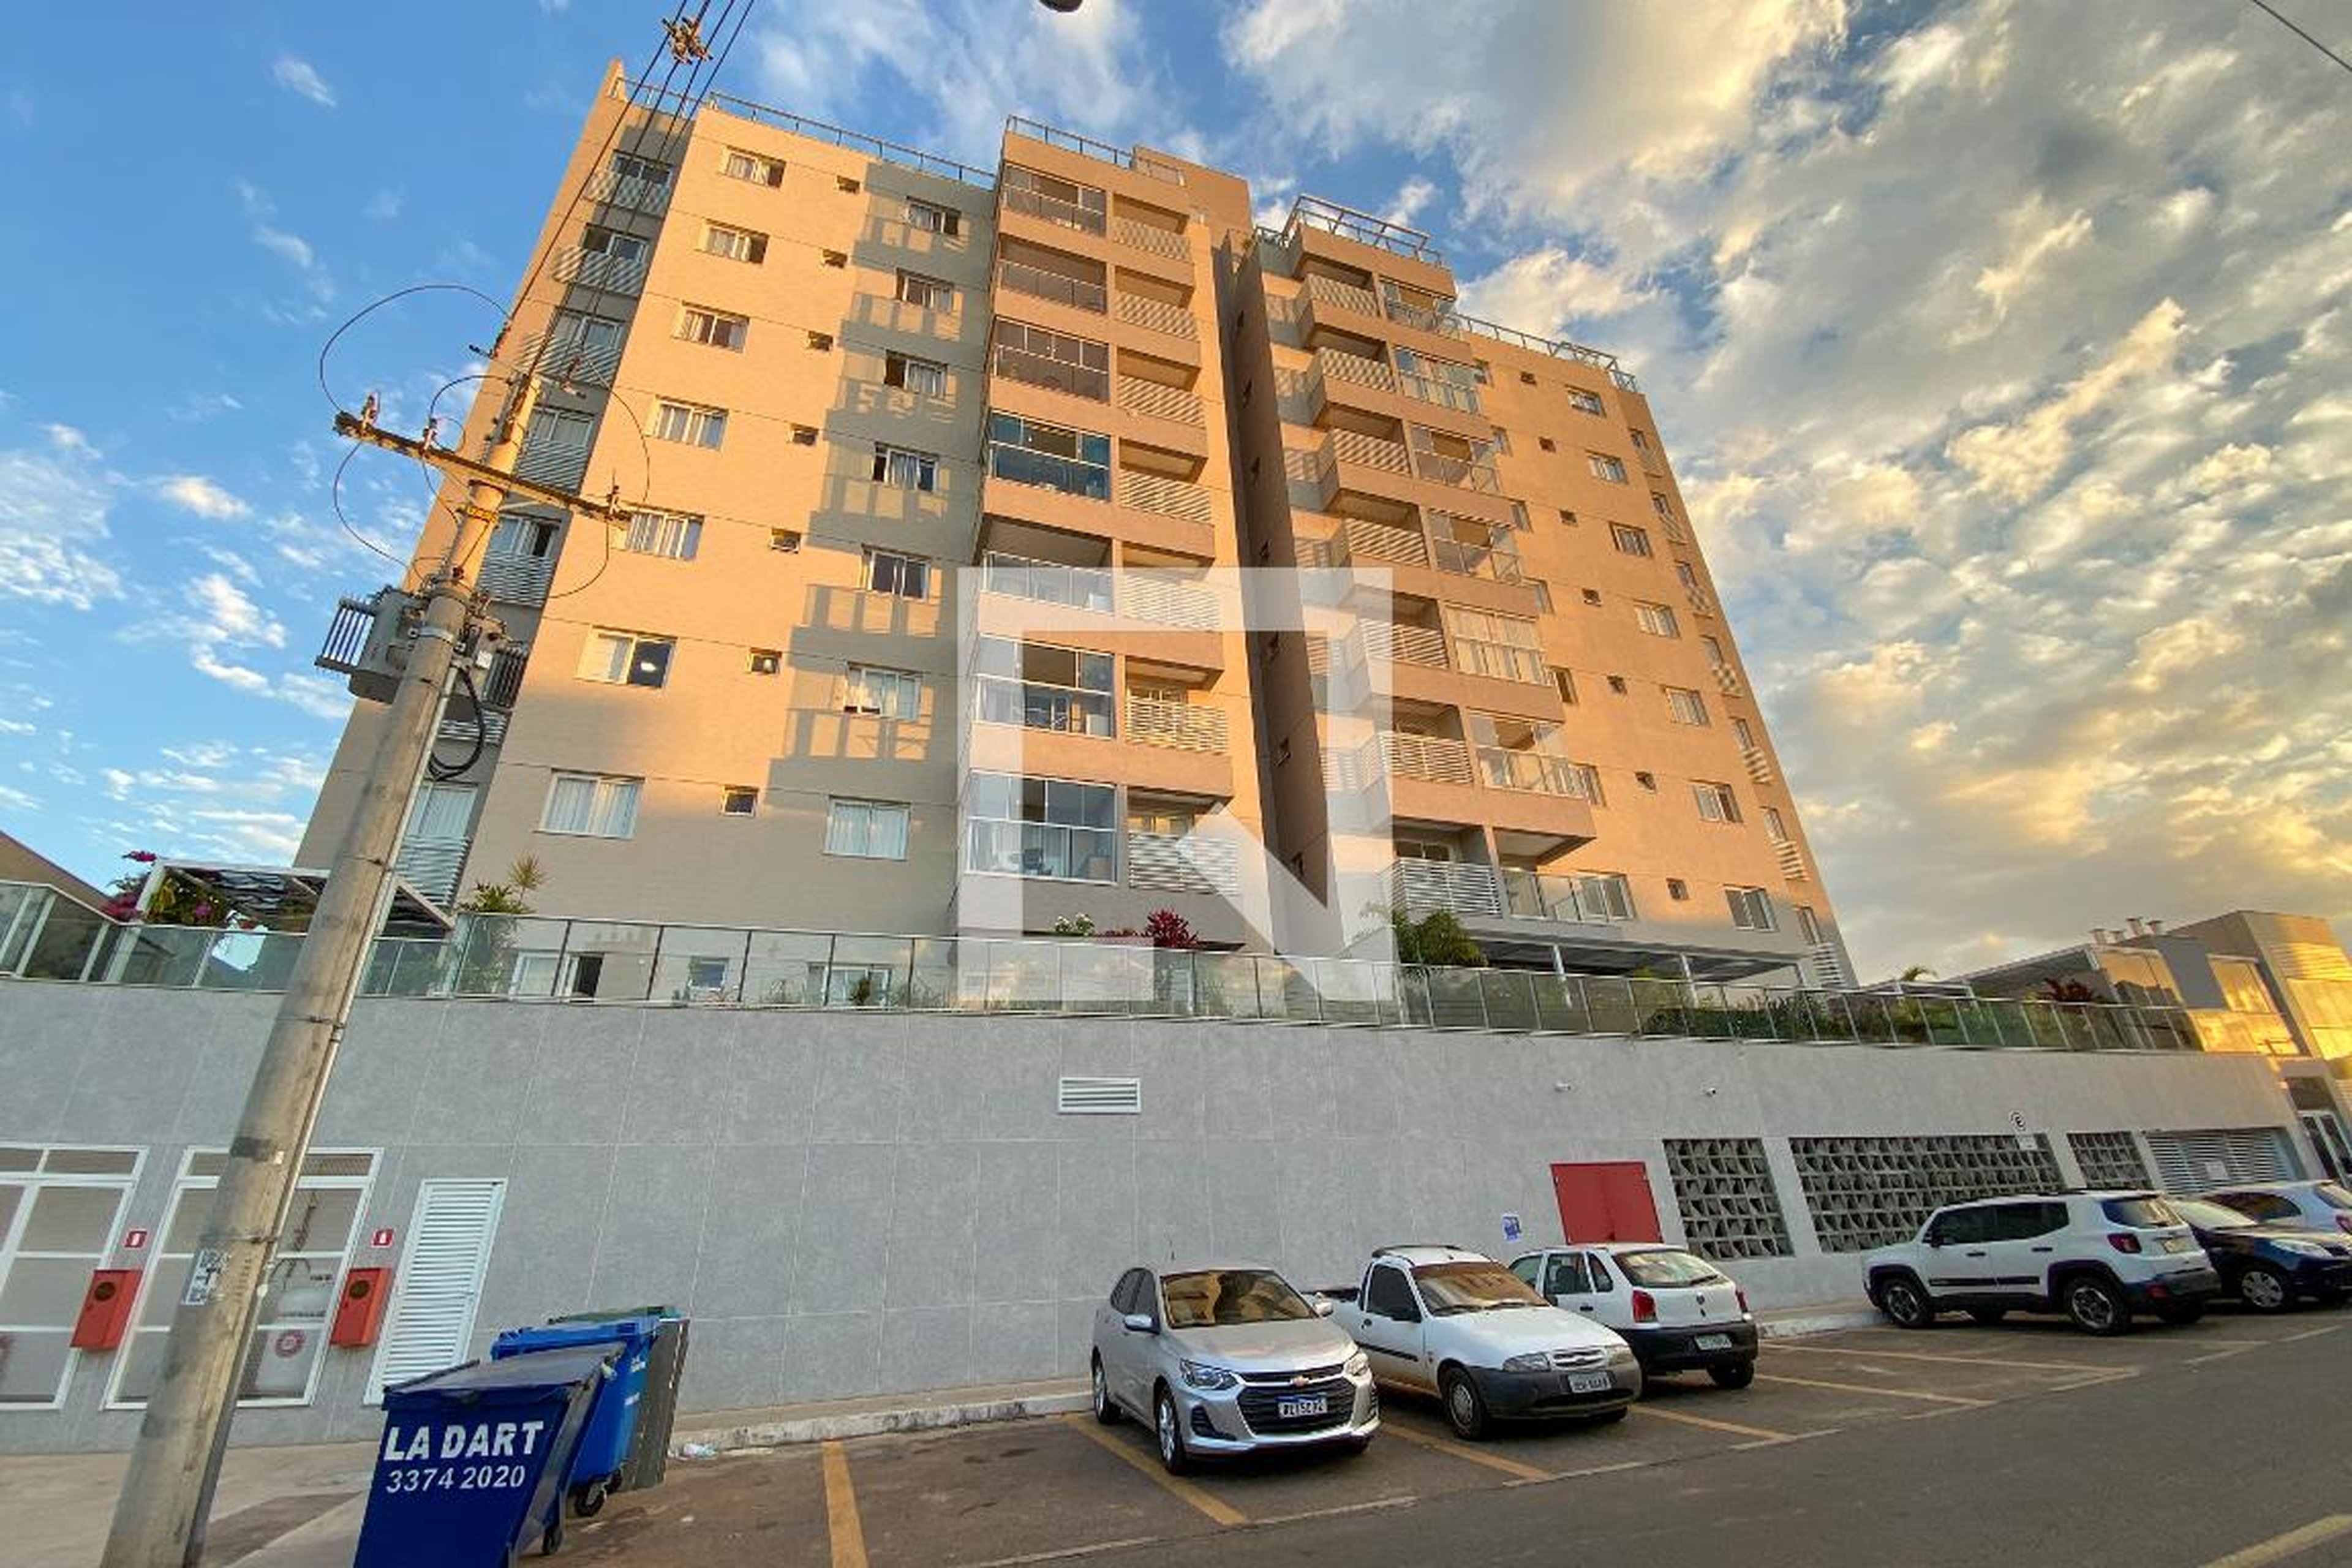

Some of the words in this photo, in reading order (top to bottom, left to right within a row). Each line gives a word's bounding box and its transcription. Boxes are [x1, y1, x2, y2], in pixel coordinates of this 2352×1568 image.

[383, 1427, 429, 1461] LA
[440, 1421, 543, 1458] DART
[386, 1468, 454, 1493] 3374
[460, 1466, 526, 1489] 2020
